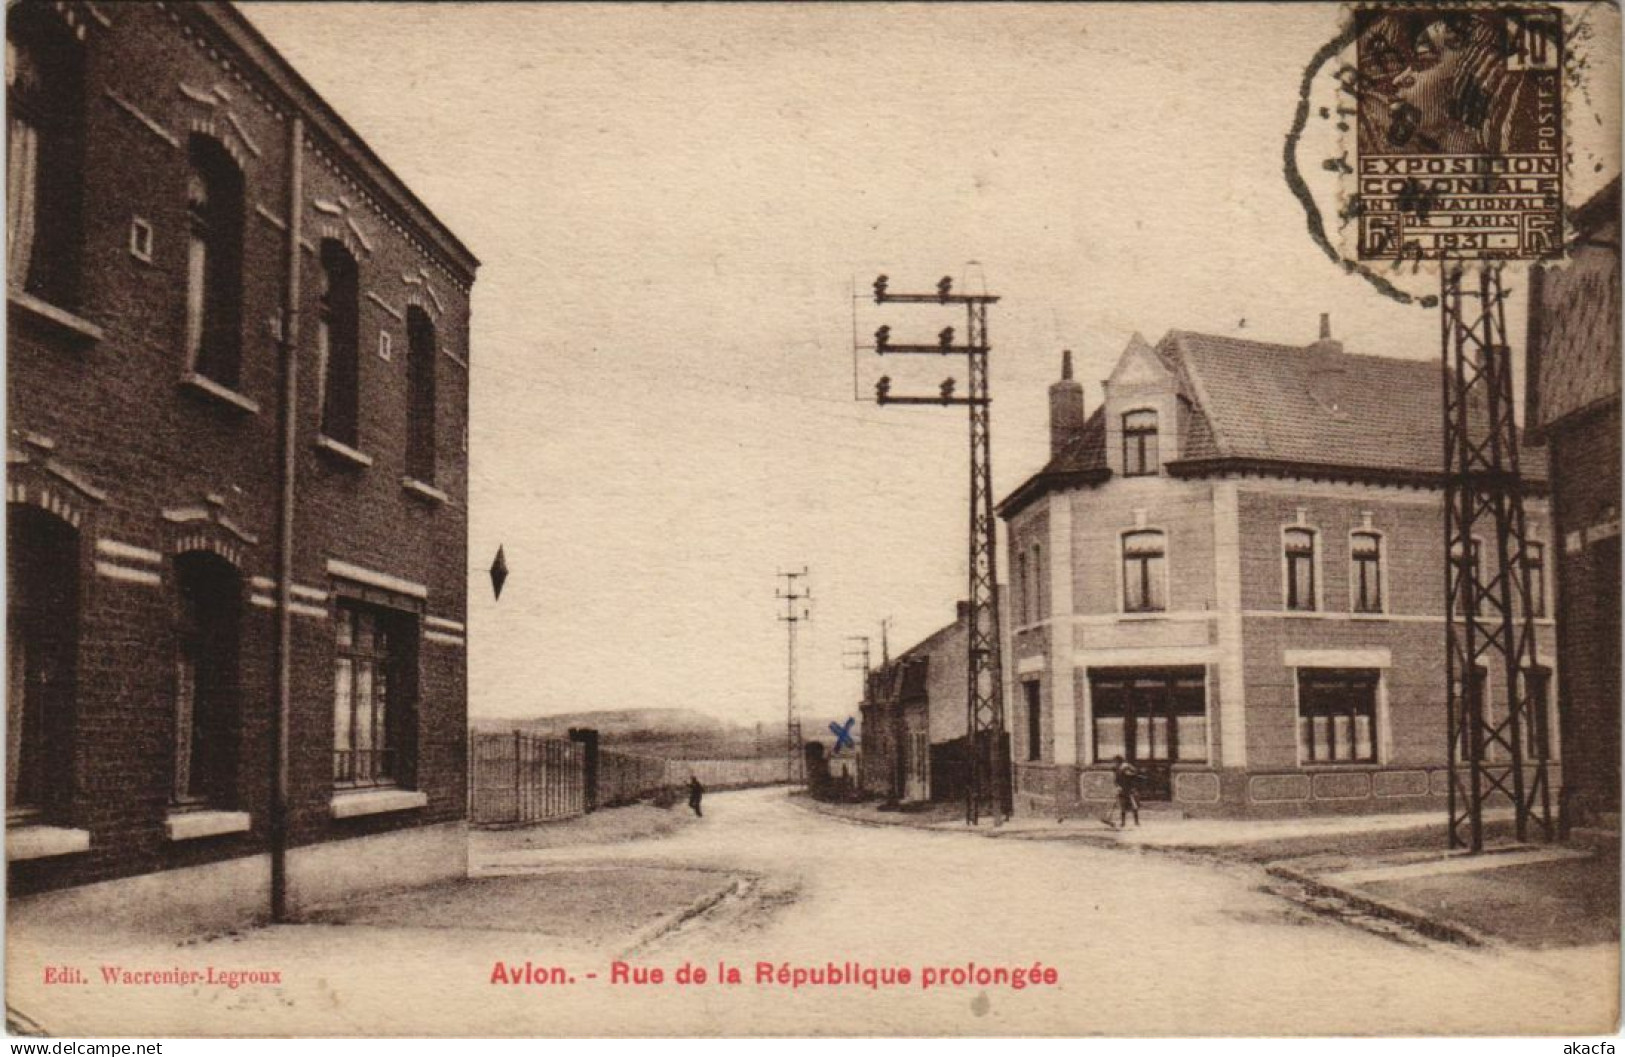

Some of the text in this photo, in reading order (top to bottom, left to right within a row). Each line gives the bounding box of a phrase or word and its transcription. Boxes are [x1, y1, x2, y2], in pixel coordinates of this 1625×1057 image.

[1538, 74, 1556, 151] POSTES
[1363, 157, 1557, 174] EXPOSITION
[1360, 198, 1556, 211] NTNATIONALE
[1452, 215, 1515, 227] PARIS
[1433, 233, 1488, 250] 1931
